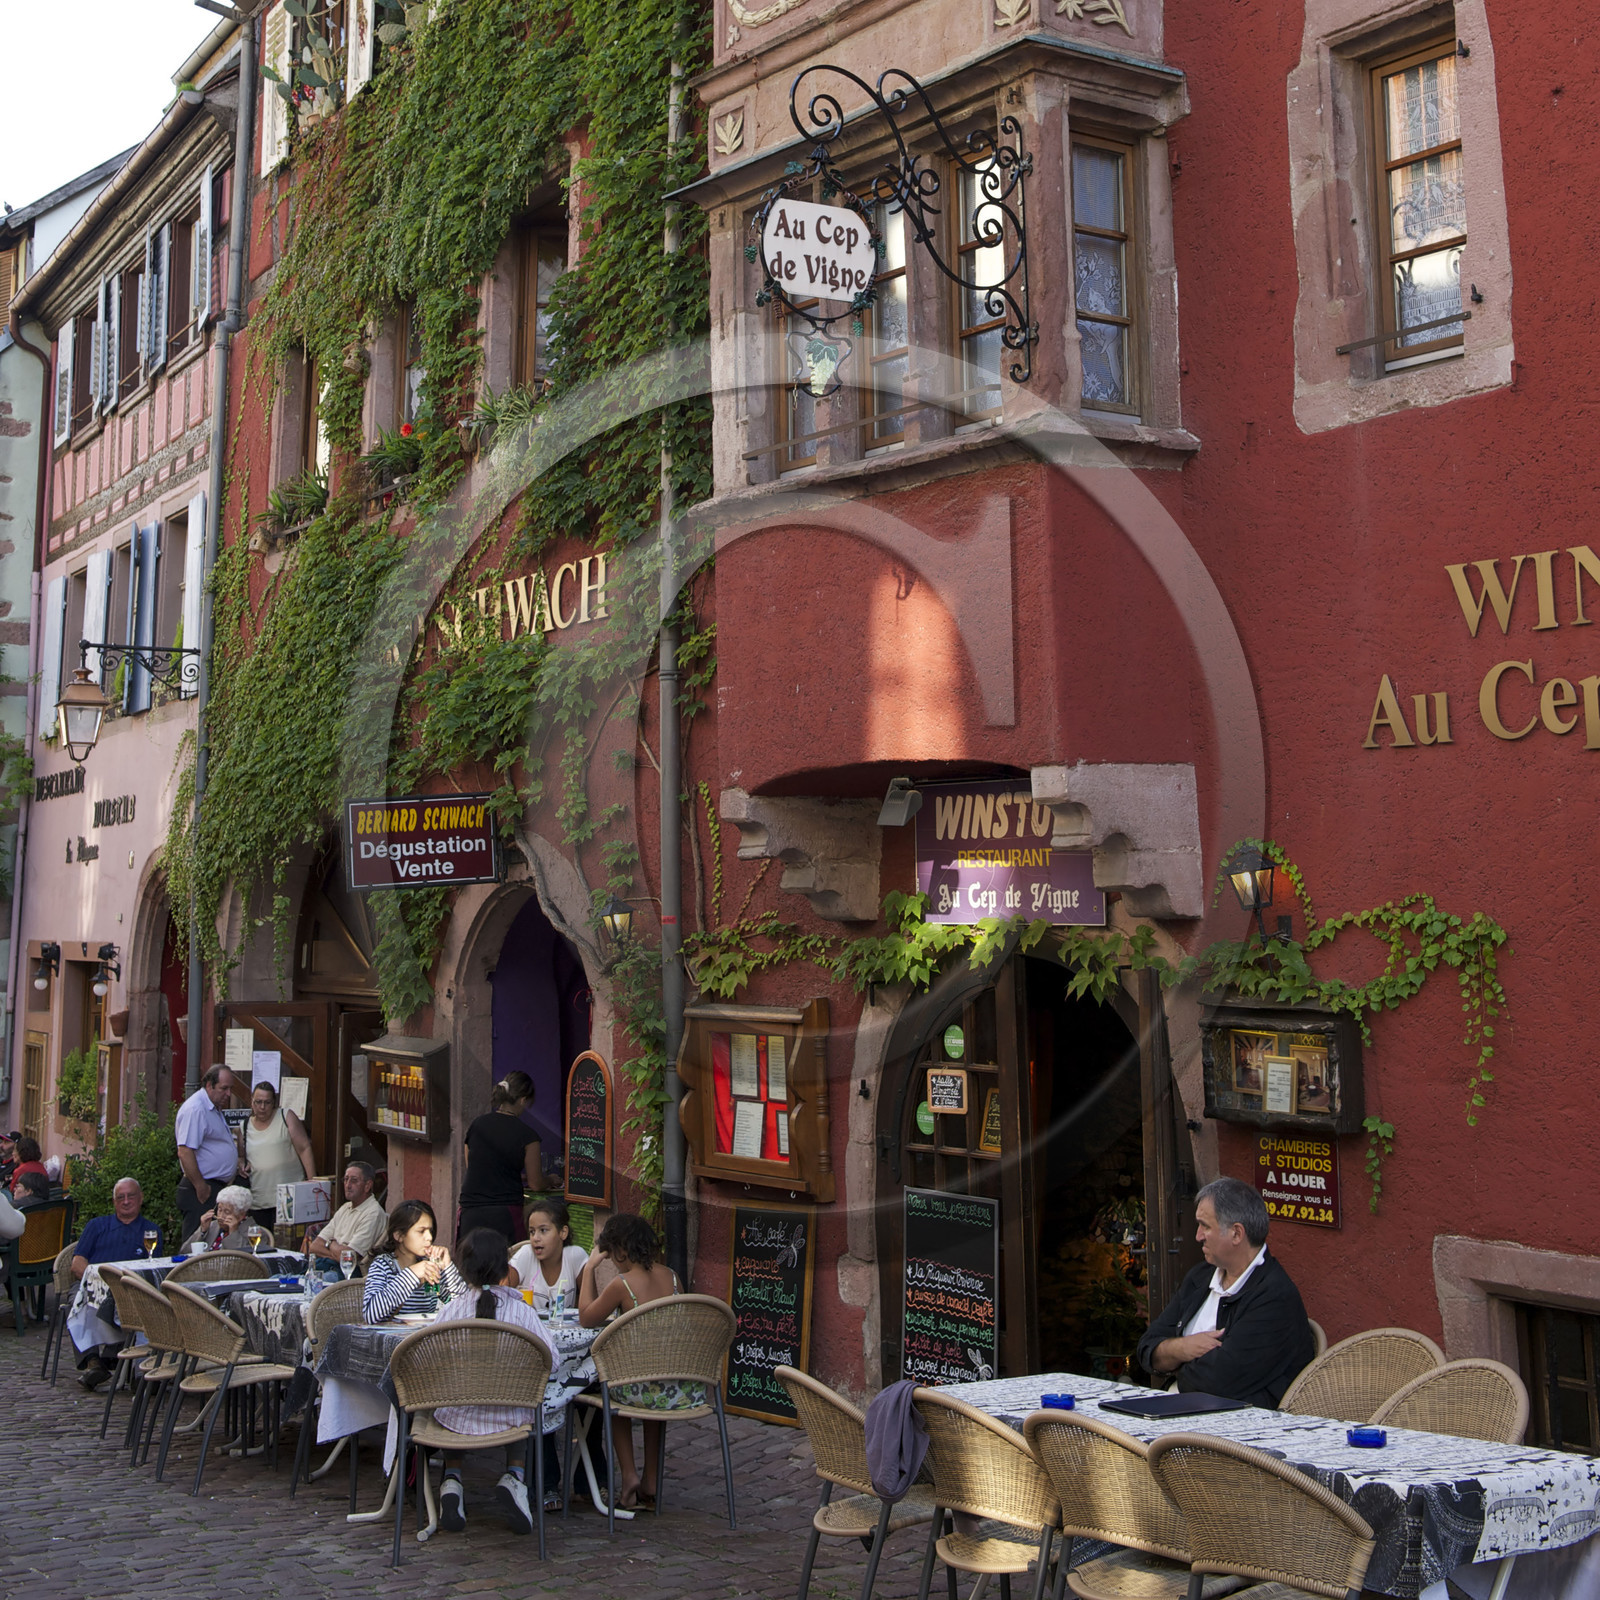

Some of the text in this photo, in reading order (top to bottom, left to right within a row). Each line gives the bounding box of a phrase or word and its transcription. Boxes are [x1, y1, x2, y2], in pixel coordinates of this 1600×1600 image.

[773, 208, 859, 254] Au Cep
[769, 251, 867, 294] de Vigne
[1444, 545, 1600, 638] WIN
[1361, 673, 1454, 748] Au
[356, 804, 485, 835] BERNARD SCHWACH
[935, 791, 1051, 841] WINSTU
[359, 836, 487, 861] Dégustation
[957, 848, 1053, 869] RESTAURANT
[394, 858, 455, 878] Vente
[937, 881, 1080, 915] Au Cep de Vigne
[1259, 1136, 1331, 1156] CHAMBRES
[1259, 1154, 1332, 1173] et STUDIOS
[1266, 1170, 1327, 1190] A LOUER
[1262, 1188, 1332, 1205] Renseignez vous ici
